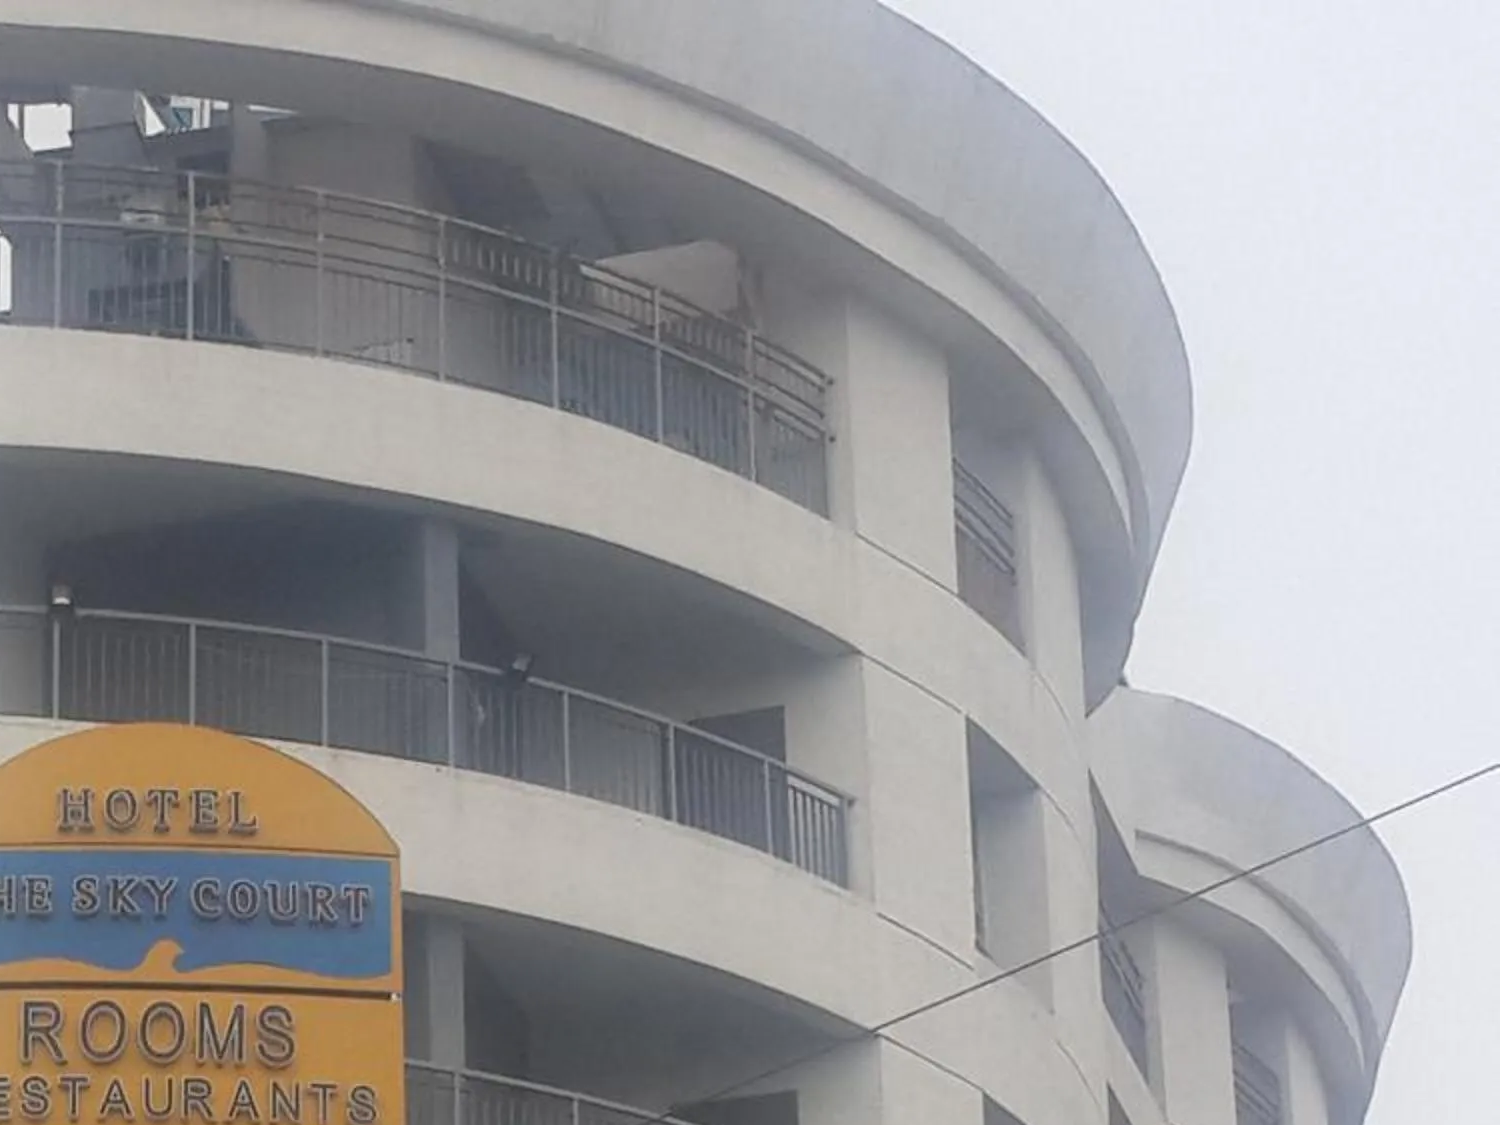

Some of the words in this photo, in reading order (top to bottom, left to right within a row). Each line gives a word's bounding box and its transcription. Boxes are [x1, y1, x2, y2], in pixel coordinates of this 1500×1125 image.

[57, 787, 258, 836] HOTEL
[71, 875, 179, 918] SKY
[190, 879, 371, 926] COURT
[20, 1000, 296, 1068] ROOMS
